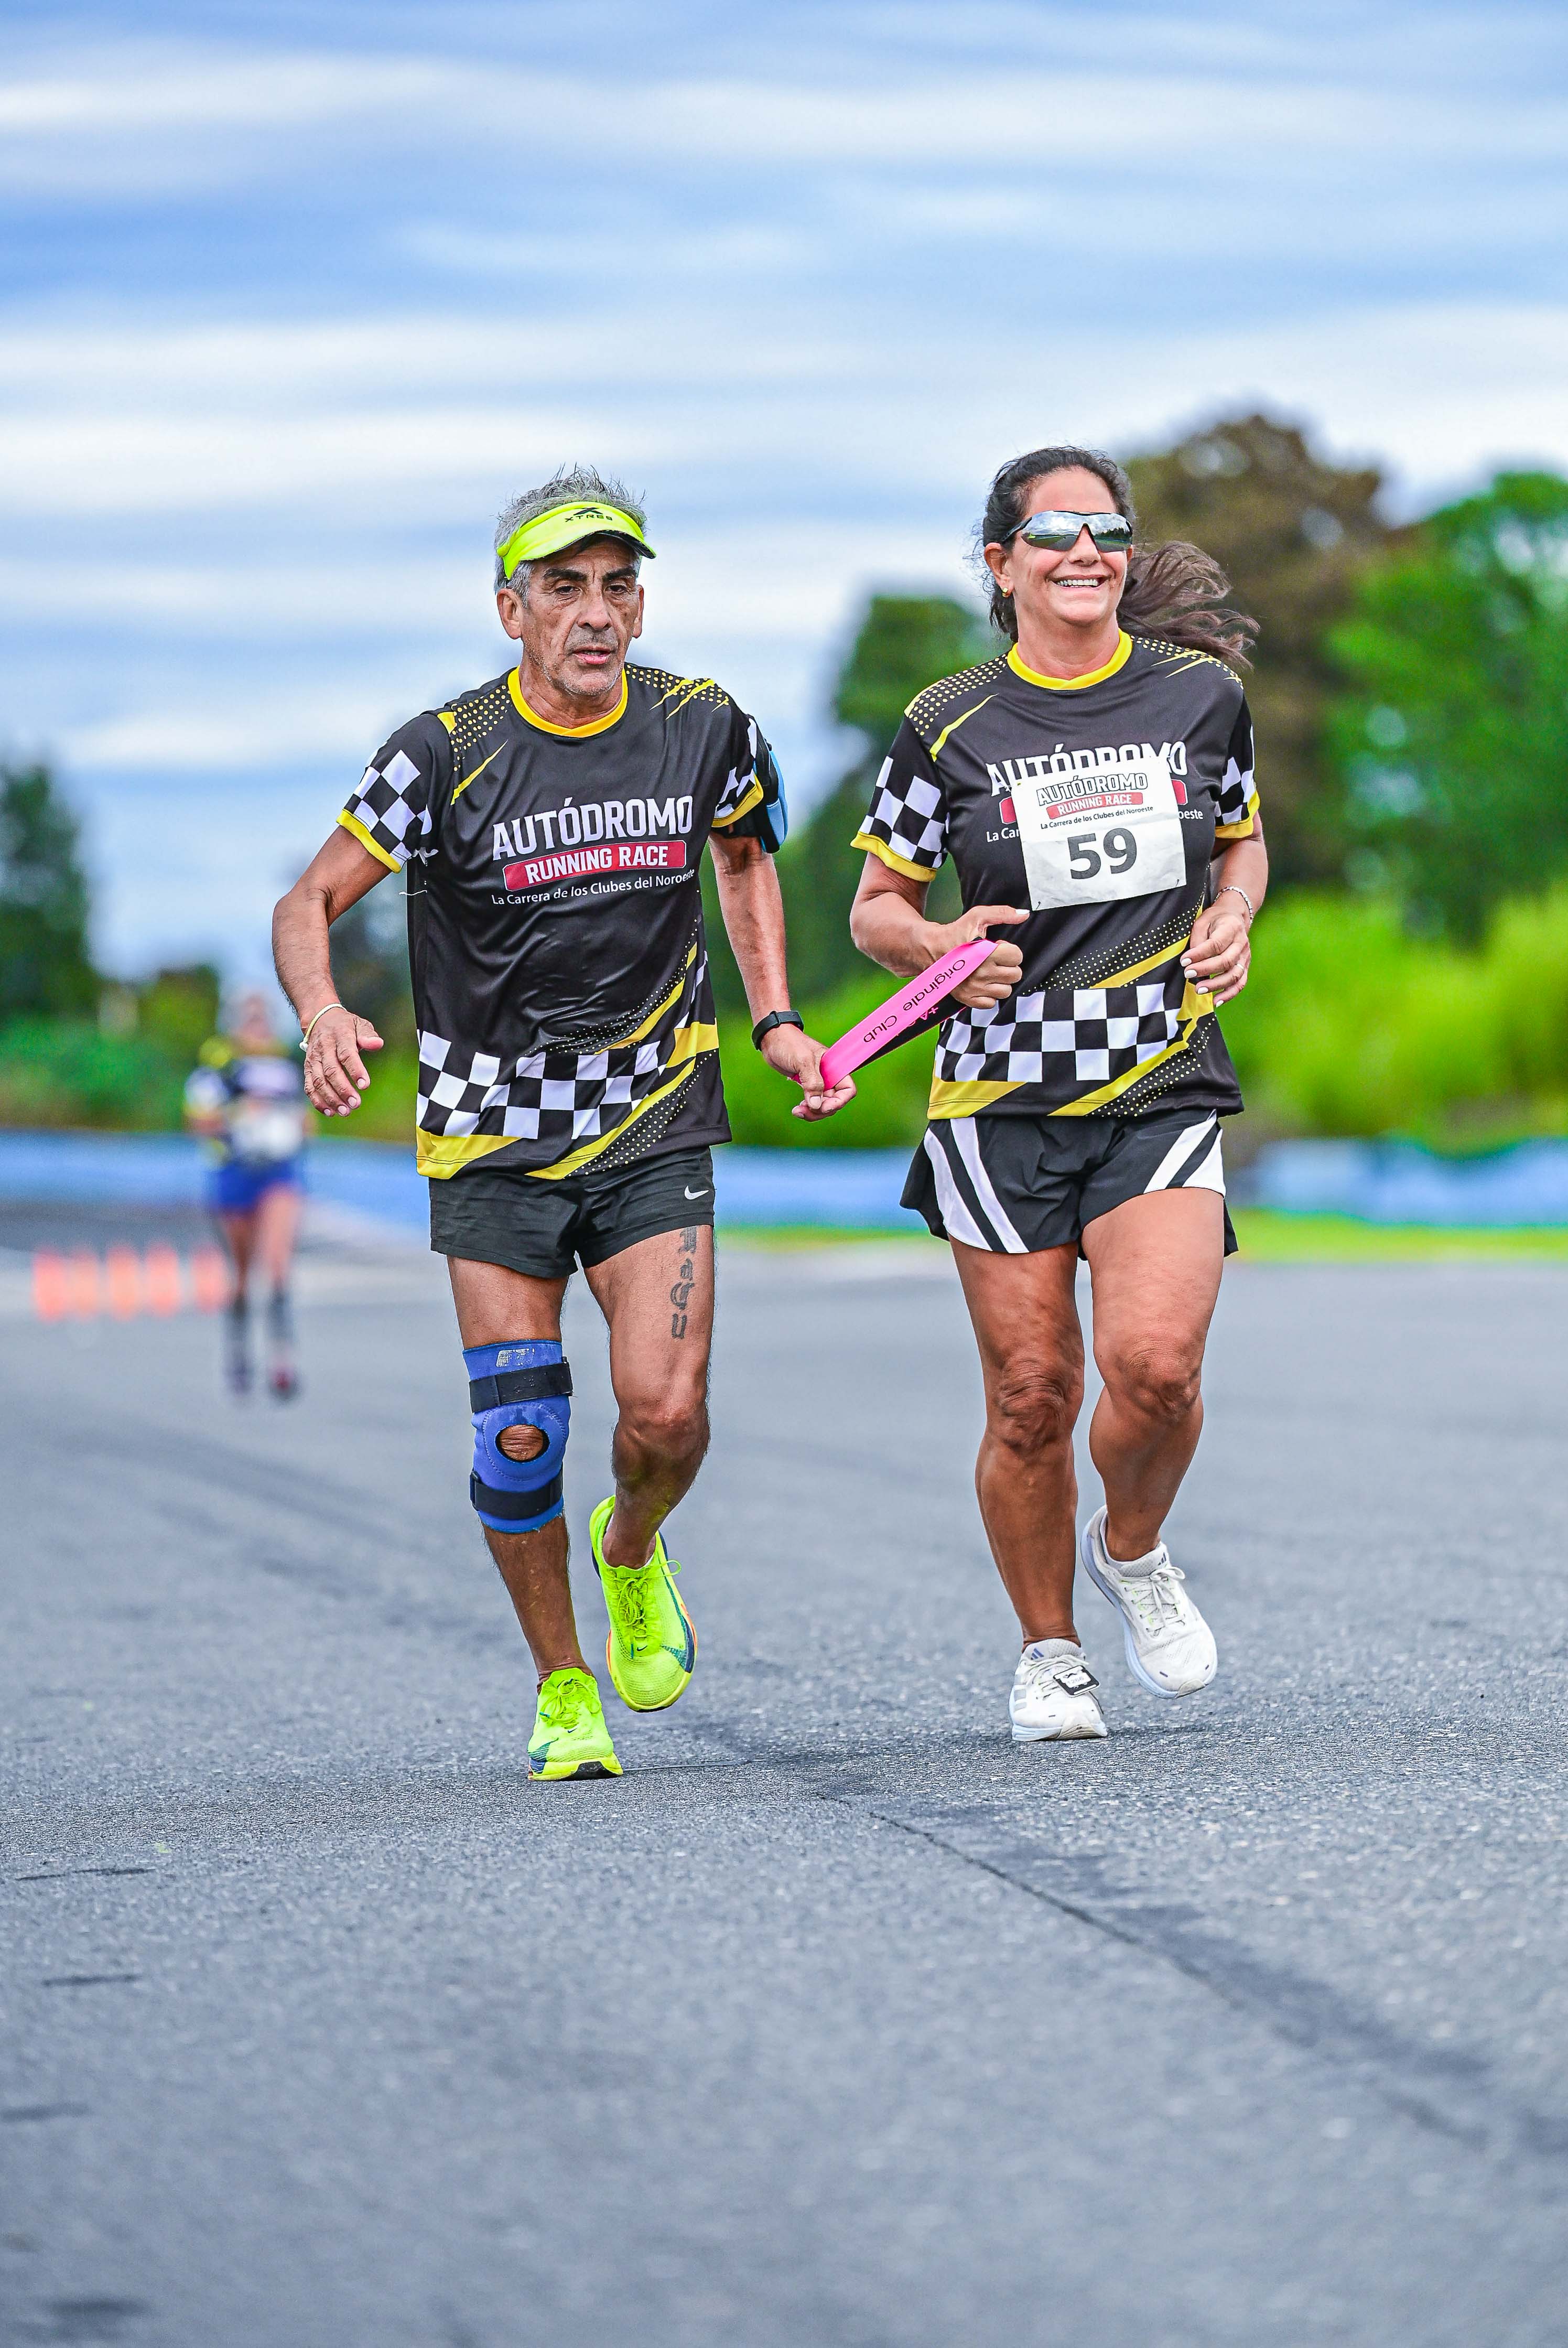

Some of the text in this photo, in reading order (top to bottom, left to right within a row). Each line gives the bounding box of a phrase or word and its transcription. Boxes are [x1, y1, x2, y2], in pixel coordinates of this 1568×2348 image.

[1036, 772, 1148, 806] AUTÓDROMO
[1056, 794, 1133, 815] RUNNING RACE
[493, 795, 693, 860] AUTÓDROMO
[986, 831, 999, 842] La
[1178, 809, 1204, 820] oeste
[1094, 811, 1114, 820] Clubes
[524, 846, 668, 884] RUNNING RACE
[1067, 828, 1137, 879] 59
[491, 869, 695, 904] La Carrera de los Clubes del Noroeste
[903, 960, 966, 1011] Originale
[863, 1015, 897, 1043] Club
